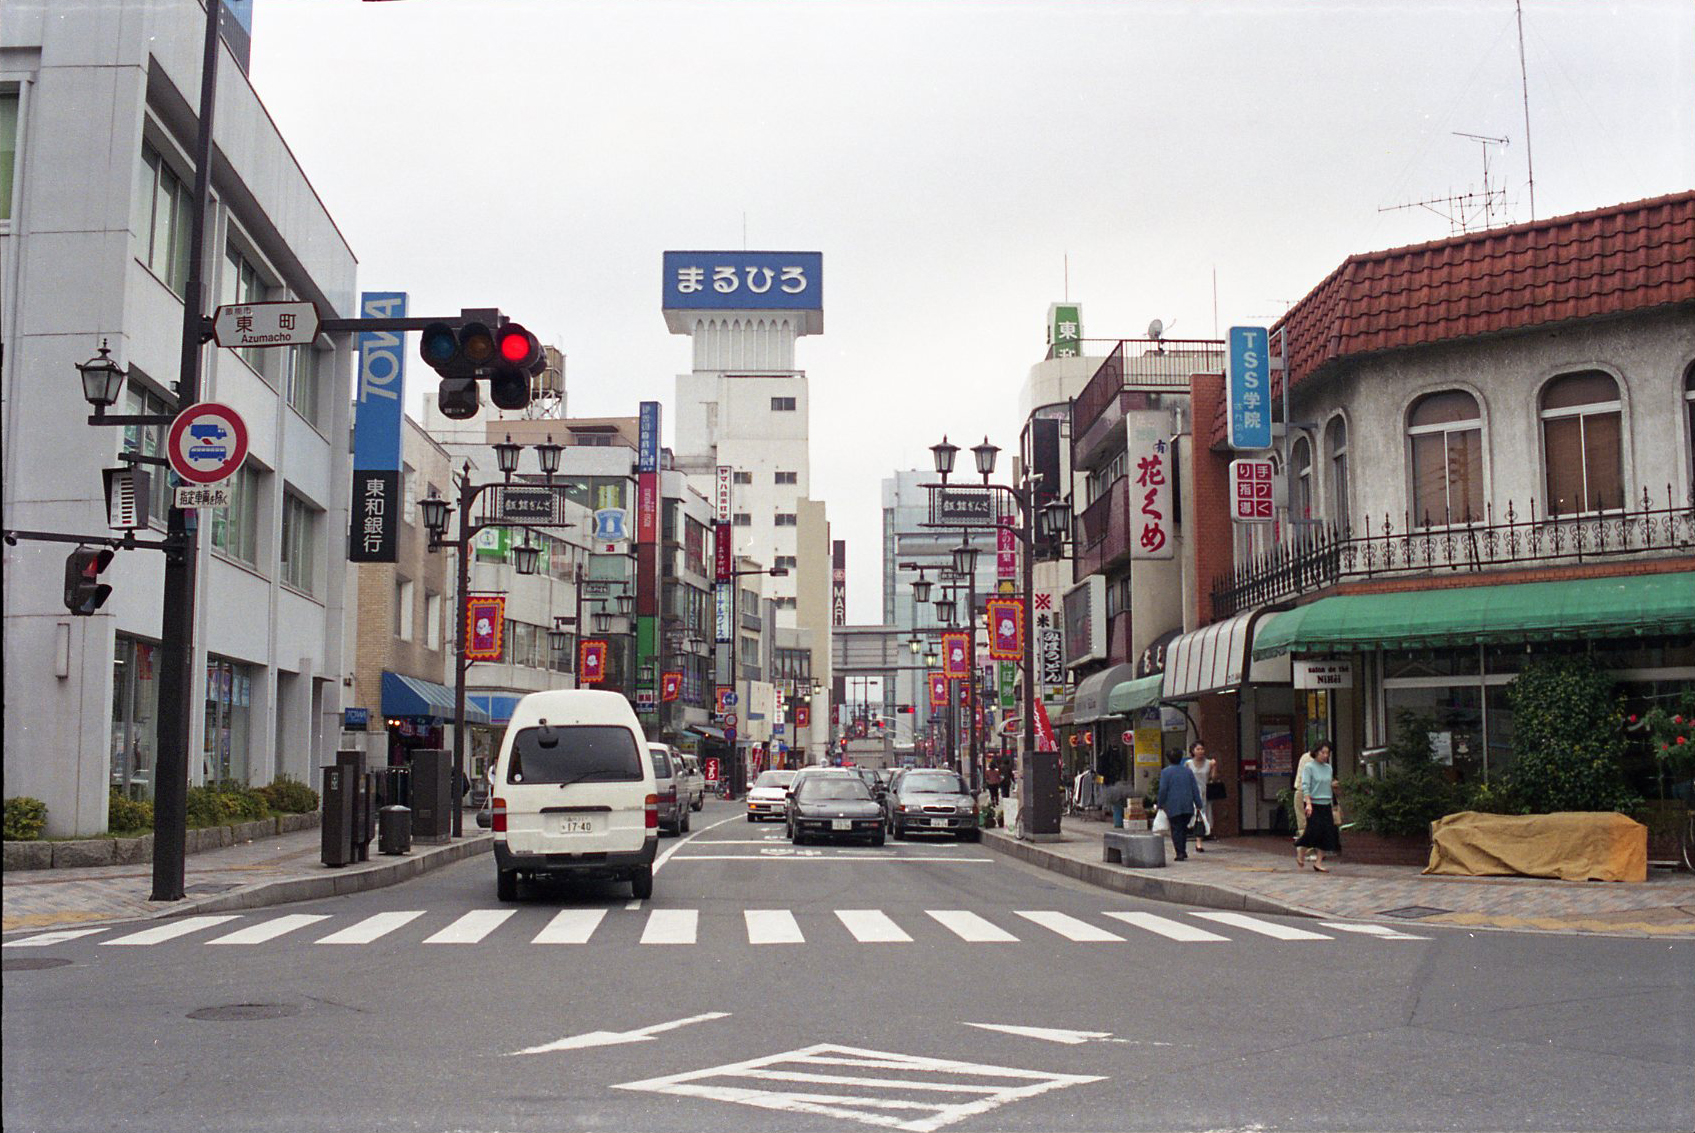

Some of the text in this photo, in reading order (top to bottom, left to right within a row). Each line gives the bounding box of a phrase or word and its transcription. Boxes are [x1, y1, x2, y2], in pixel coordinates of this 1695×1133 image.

[677, 265, 808, 294] まるひろ
[235, 313, 297, 333] 東町
[241, 332, 291, 343] Azumacho
[1242, 332, 1261, 429] TSS学院
[180, 490, 227, 505] 指定車両を除く
[1136, 454, 1166, 553] 花くめ
[1256, 465, 1270, 515] 手づく
[363, 478, 386, 554] 東和銀行
